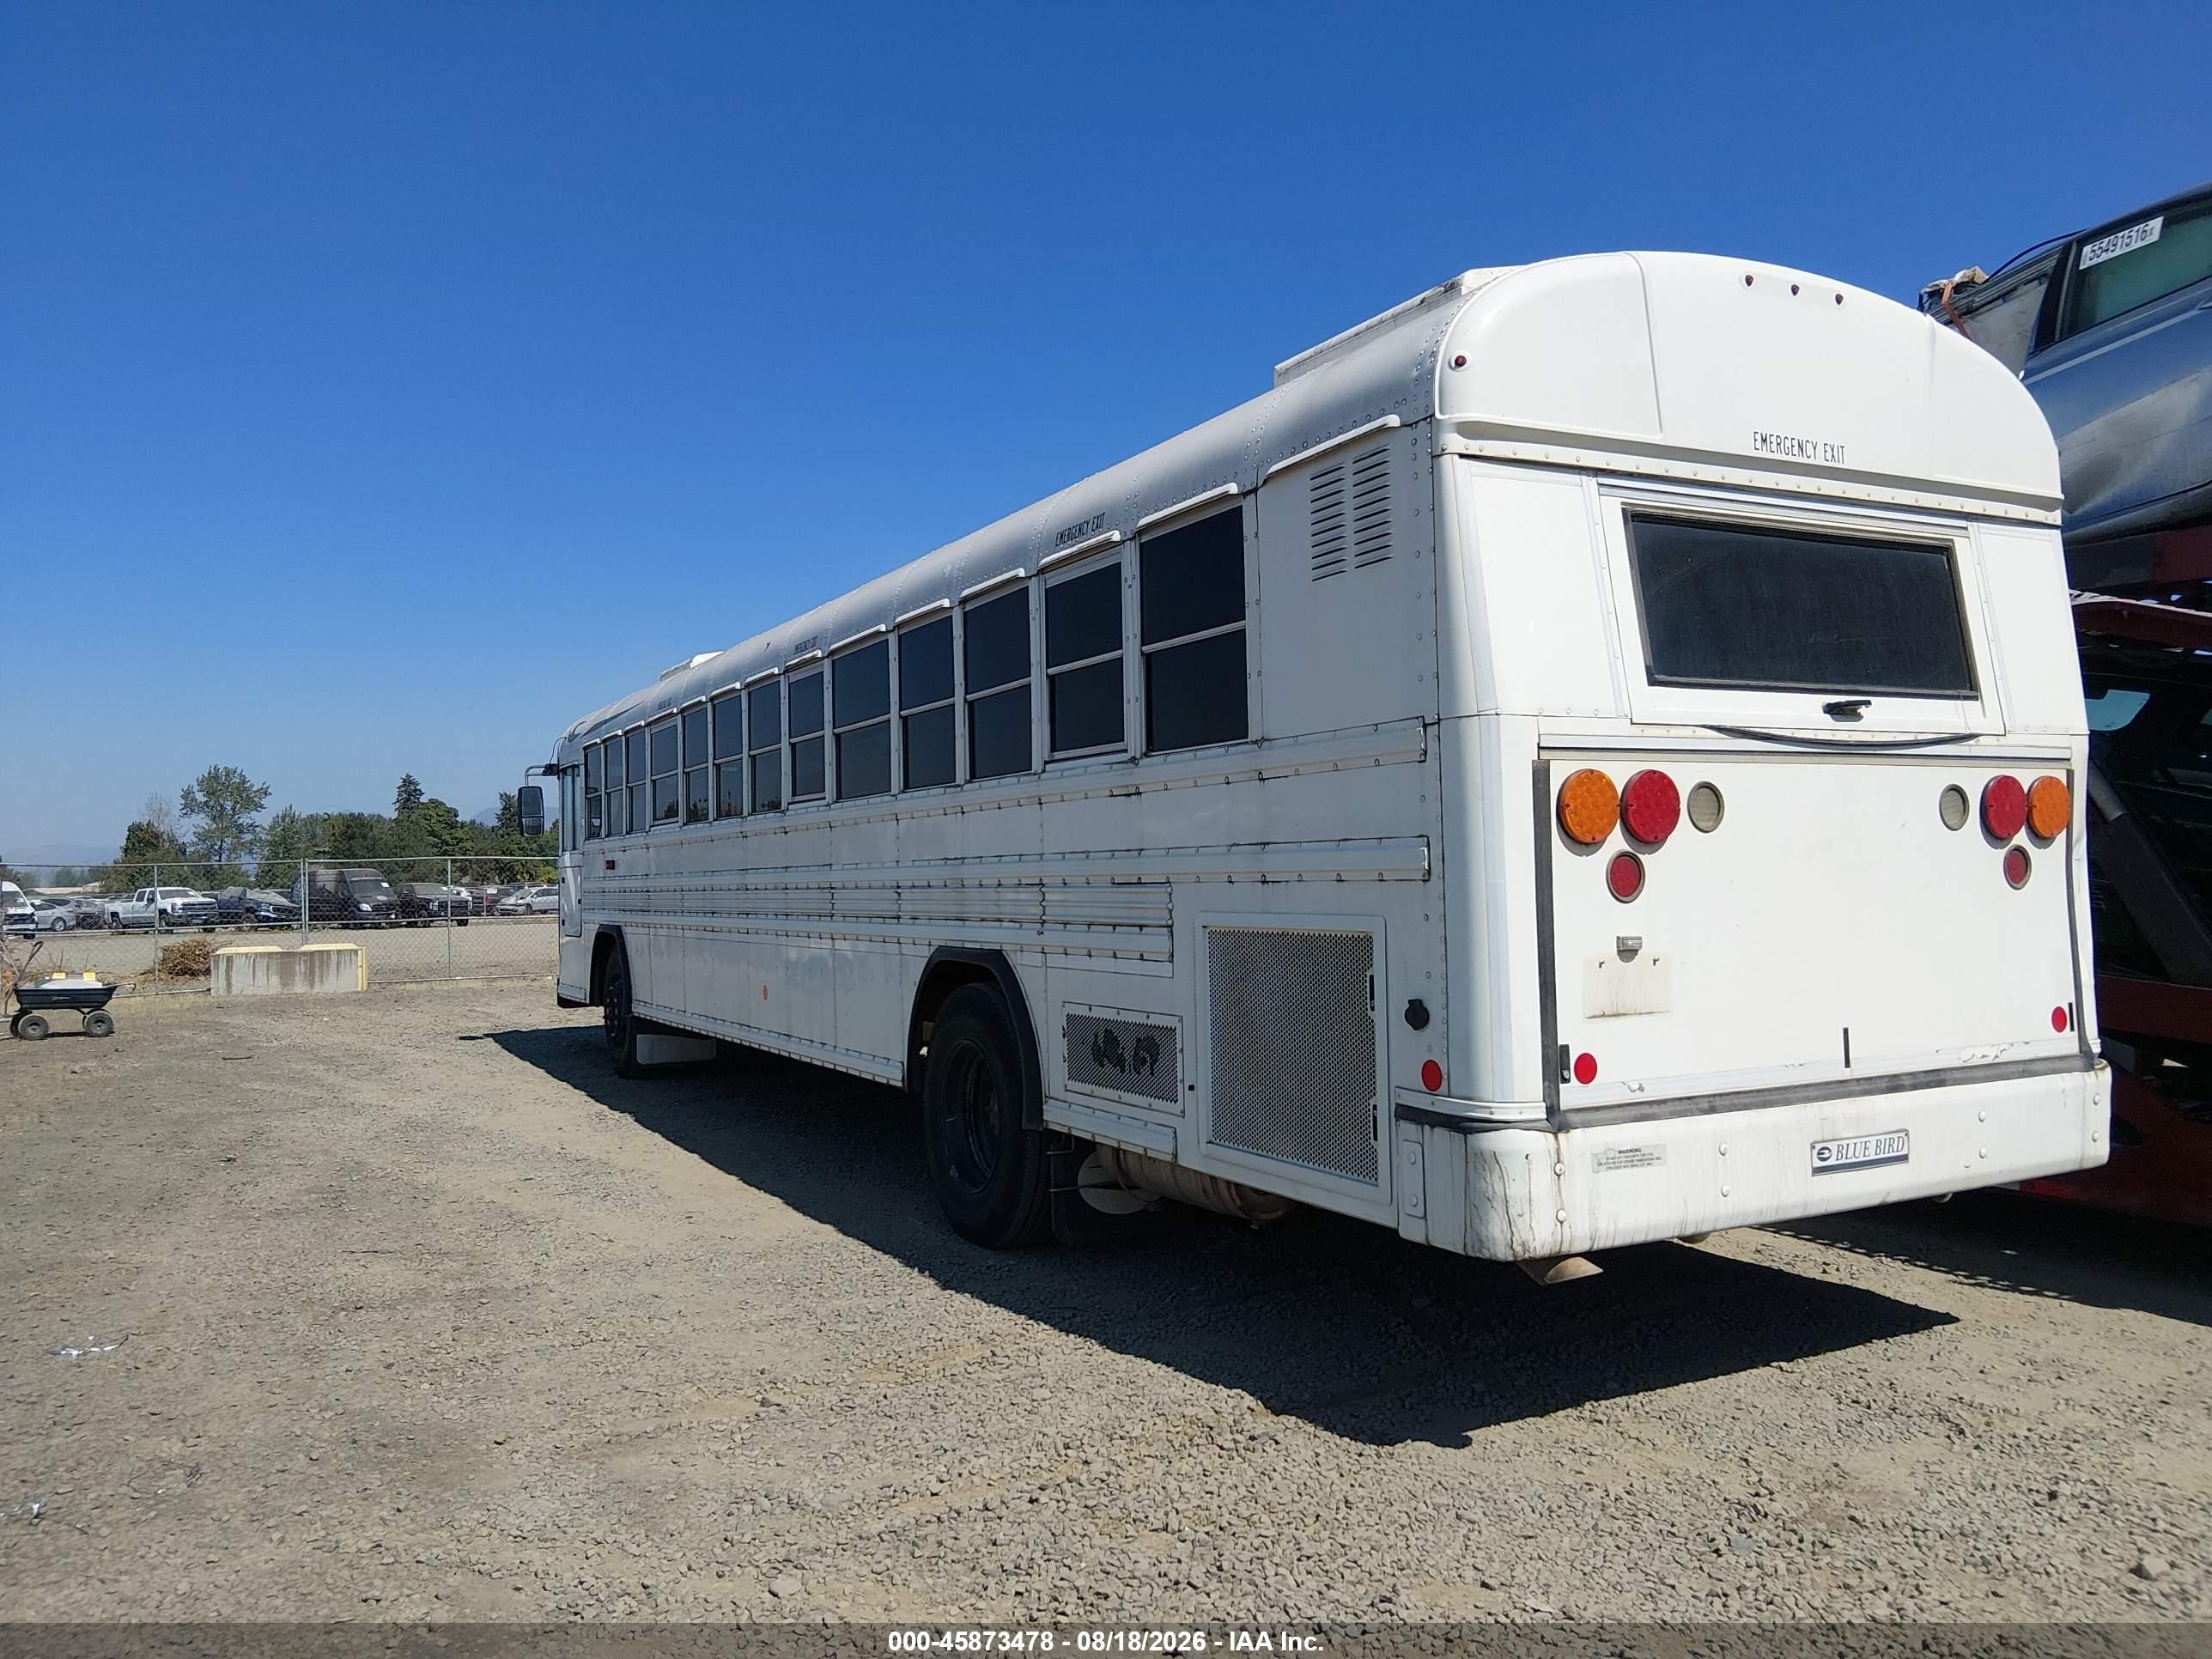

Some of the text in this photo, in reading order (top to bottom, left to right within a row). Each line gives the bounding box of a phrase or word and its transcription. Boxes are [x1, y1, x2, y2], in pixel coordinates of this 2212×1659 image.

[2088, 224, 2149, 261] 55491516
[1753, 431, 1845, 465] EMERGENCY EXIT
[1055, 511, 1105, 547] EMERGENCY EXIT
[1835, 1135, 1905, 1162] BLUE BIRD
